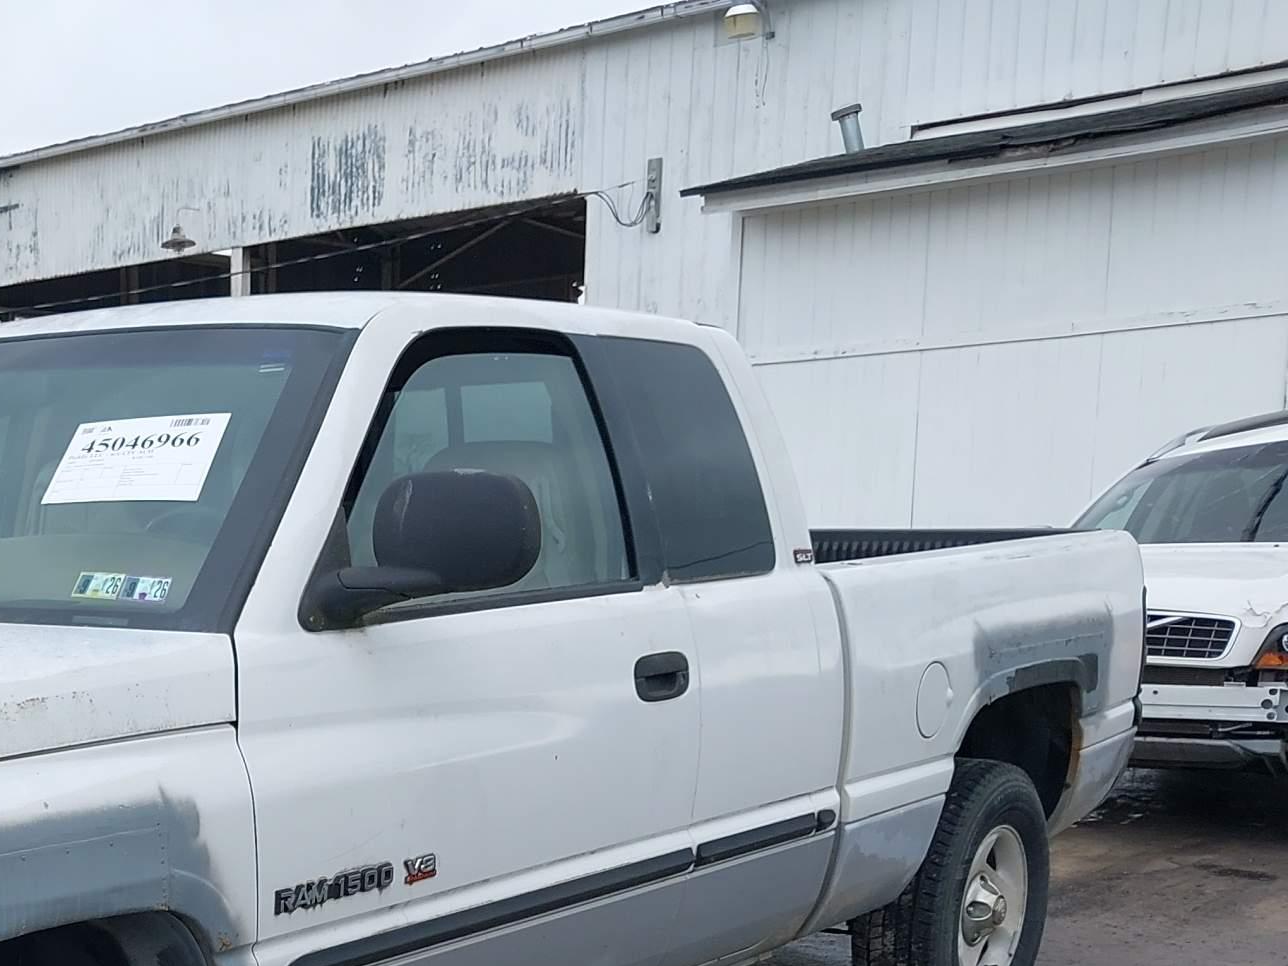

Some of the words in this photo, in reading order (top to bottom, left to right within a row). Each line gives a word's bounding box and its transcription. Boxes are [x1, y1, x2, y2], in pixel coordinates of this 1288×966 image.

[81, 431, 203, 454] 45046966
[274, 876, 330, 915] RAM
[331, 862, 394, 899] 1500
